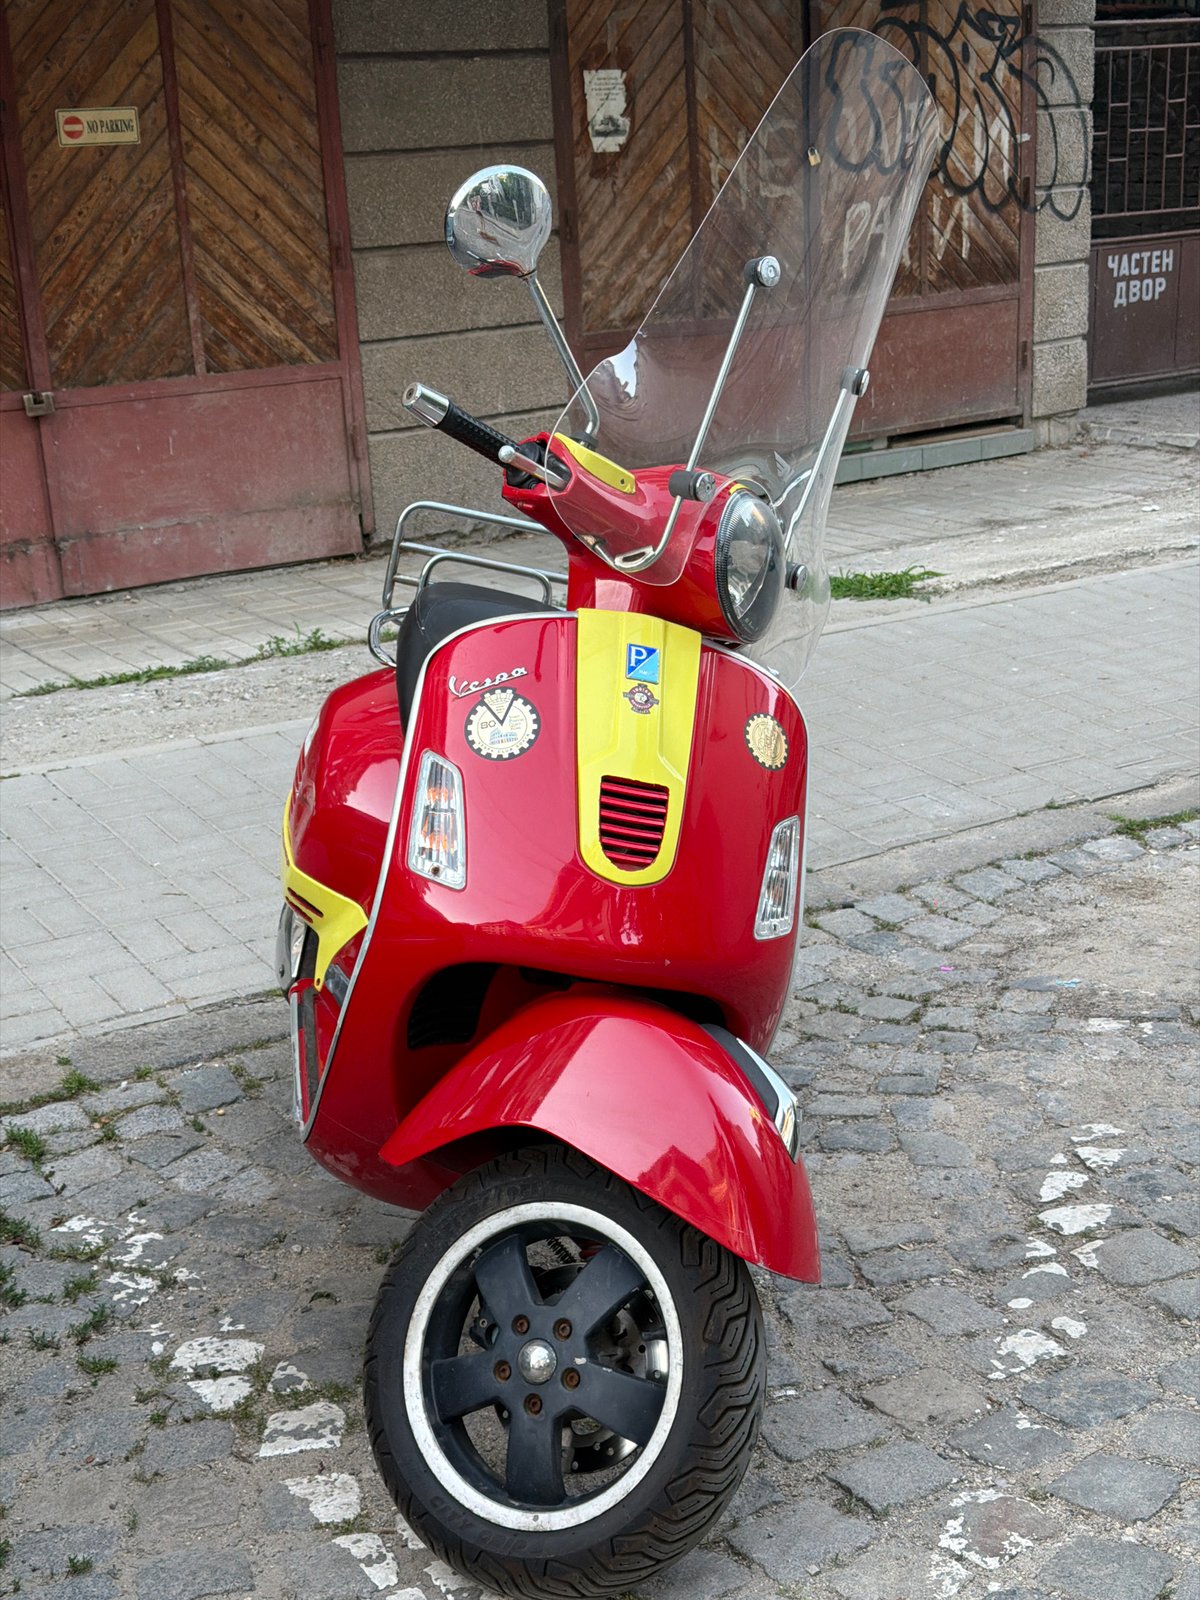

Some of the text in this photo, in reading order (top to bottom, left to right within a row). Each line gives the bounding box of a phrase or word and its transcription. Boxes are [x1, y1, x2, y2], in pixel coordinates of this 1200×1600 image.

[86, 119, 134, 134] NO PARKING
[1107, 249, 1173, 278] ЧАСТЕН
[1113, 277, 1166, 308] ДВОР
[630, 645, 648, 667] P
[448, 667, 528, 698] Vespa
